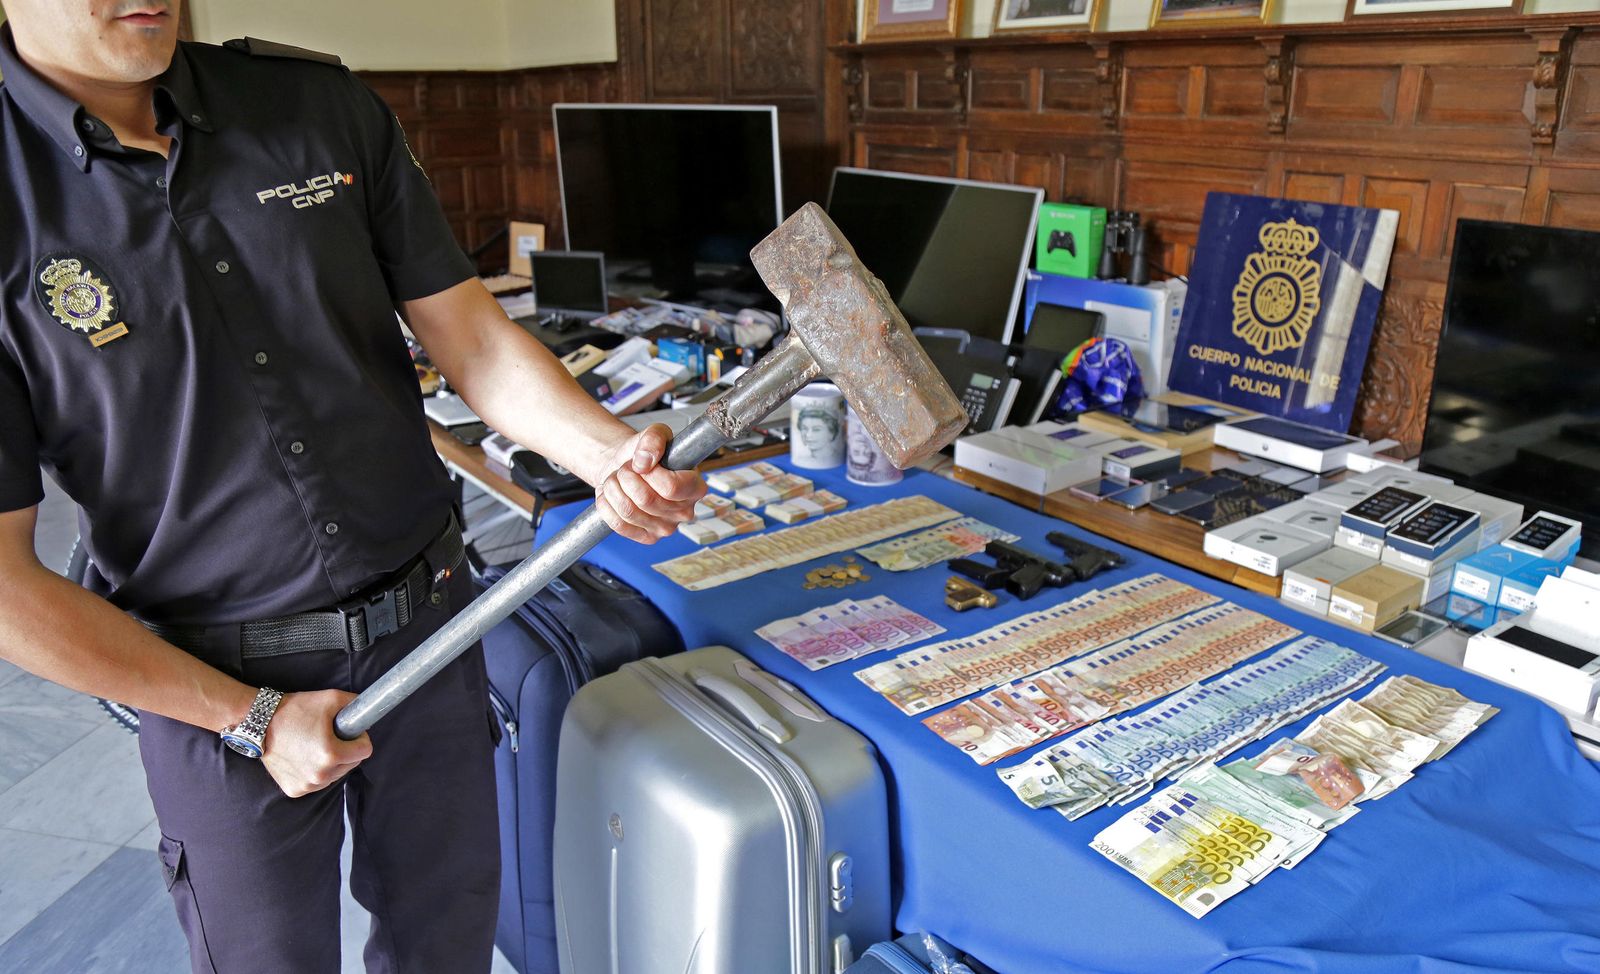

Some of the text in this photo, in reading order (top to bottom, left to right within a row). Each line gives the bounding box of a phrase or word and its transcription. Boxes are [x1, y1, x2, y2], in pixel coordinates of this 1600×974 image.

[256, 171, 344, 205] POLICIA
[291, 189, 335, 209] CNP
[1188, 344, 1341, 391] CUERPO NACIONAL DE
[1229, 374, 1281, 399] POLICIA
[1039, 699, 1058, 711] 10
[960, 739, 979, 752] 10
[1041, 774, 1059, 786] 5
[1104, 765, 1134, 781] 20
[1094, 841, 1115, 856] 200
[1185, 852, 1233, 885] 200
